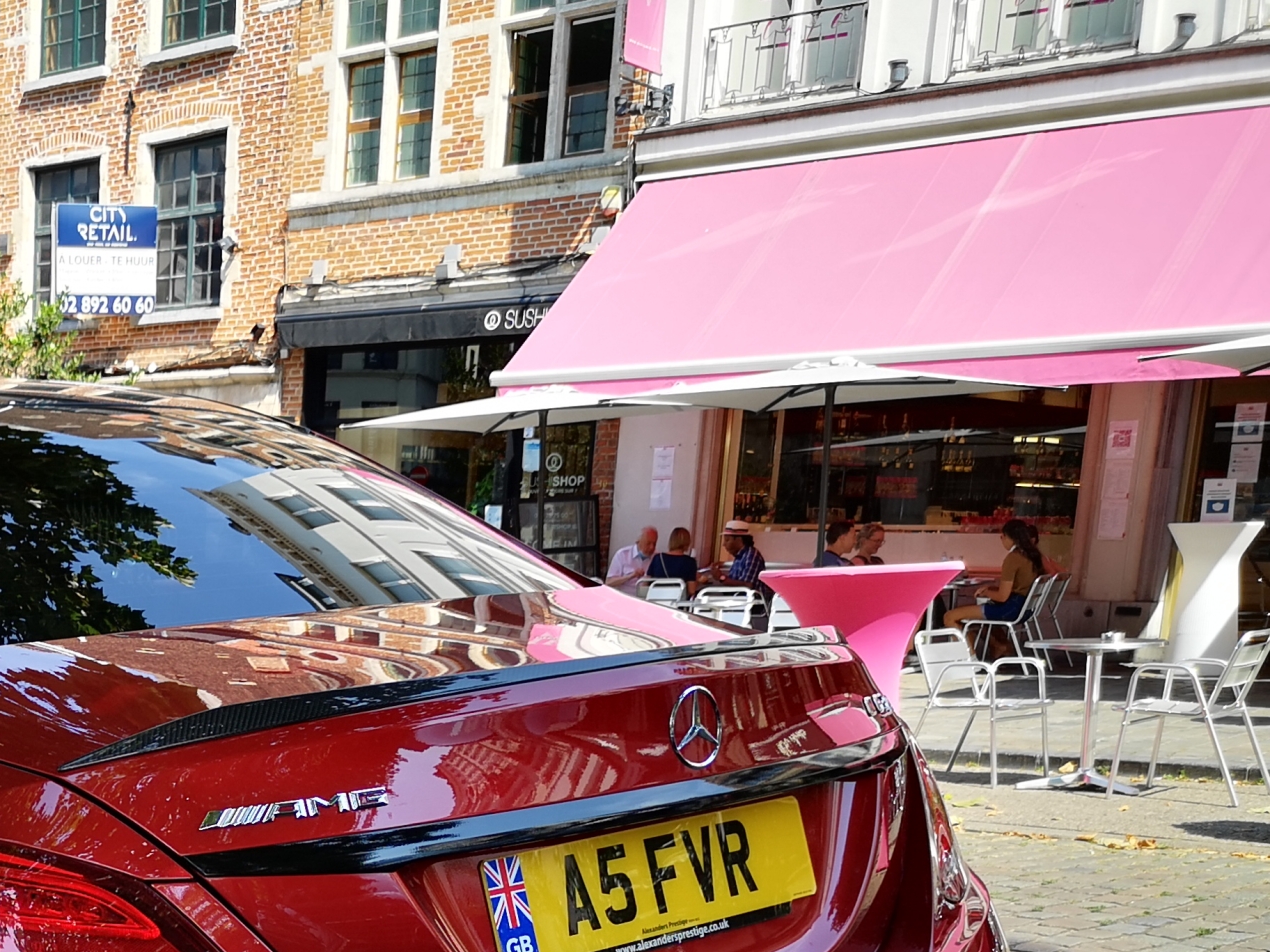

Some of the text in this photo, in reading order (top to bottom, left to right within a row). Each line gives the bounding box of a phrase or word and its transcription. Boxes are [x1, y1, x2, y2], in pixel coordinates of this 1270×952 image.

[90, 206, 127, 223] CITY
[69, 255, 102, 266] LOUER
[111, 256, 122, 266] TE
[126, 256, 154, 266] HUUR
[81, 296, 109, 313] 892
[113, 296, 132, 313] 60
[135, 296, 154, 313] 60
[258, 786, 390, 824] AMG
[564, 819, 758, 936] A5 FVR
